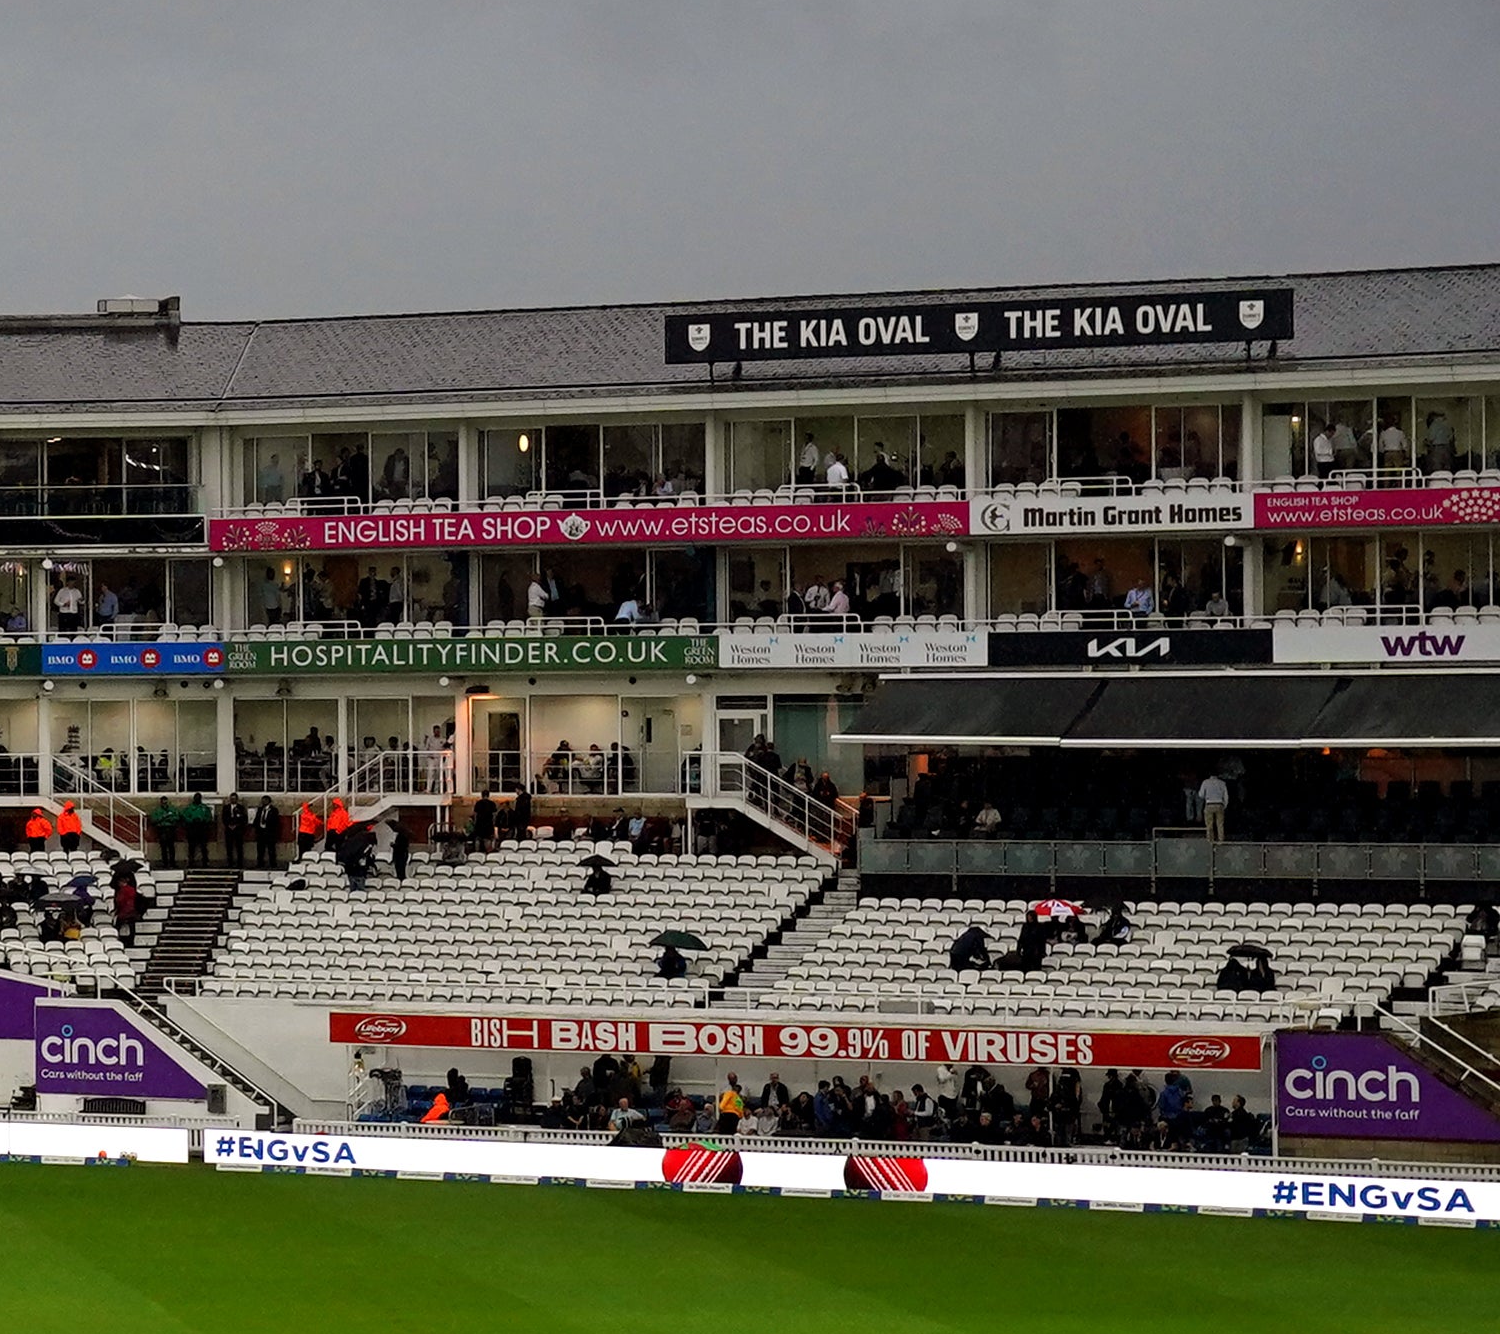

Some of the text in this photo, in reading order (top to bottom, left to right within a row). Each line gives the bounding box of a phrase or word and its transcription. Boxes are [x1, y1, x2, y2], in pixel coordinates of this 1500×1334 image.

[1004, 304, 1212, 338] THE KIA OVAL
[735, 316, 930, 349] THE KIA OVAL
[1266, 495, 1359, 508] ENGLISH TEA SHOP
[1023, 504, 1243, 528] Martin Grant Homes
[1267, 504, 1443, 525] www.etsteas.co.uk
[595, 509, 851, 537] www.etsteas.co.uk
[324, 516, 550, 545] ENGLISH TEA SHOP
[730, 644, 771, 655] Weston
[794, 643, 836, 654] Weston
[859, 642, 901, 653] Weston
[924, 642, 967, 653] Weston
[1381, 631, 1466, 657] wtw
[48, 655, 75, 665] BMO
[110, 655, 137, 664] BMO
[173, 654, 200, 664] BMO
[270, 641, 668, 667] HOSPITALITYFINDER.CO.UK
[730, 654, 771, 665] Homes
[795, 654, 835, 664] Homes
[859, 653, 901, 664] Homes
[925, 652, 968, 663] Homes
[360, 1023, 403, 1035] Lifebuoy
[41, 1024, 144, 1067] cinch
[470, 1019, 1094, 1065] BISH BASH BOSH 99.9% OF VIRUSES
[1175, 1044, 1230, 1058] Lifebuoy
[41, 1069, 144, 1083] Cars without the faff
[1284, 1055, 1422, 1103] cinch
[1285, 1105, 1420, 1122] Cars without the faff
[1272, 1180, 1476, 1213] #ENGvSA
